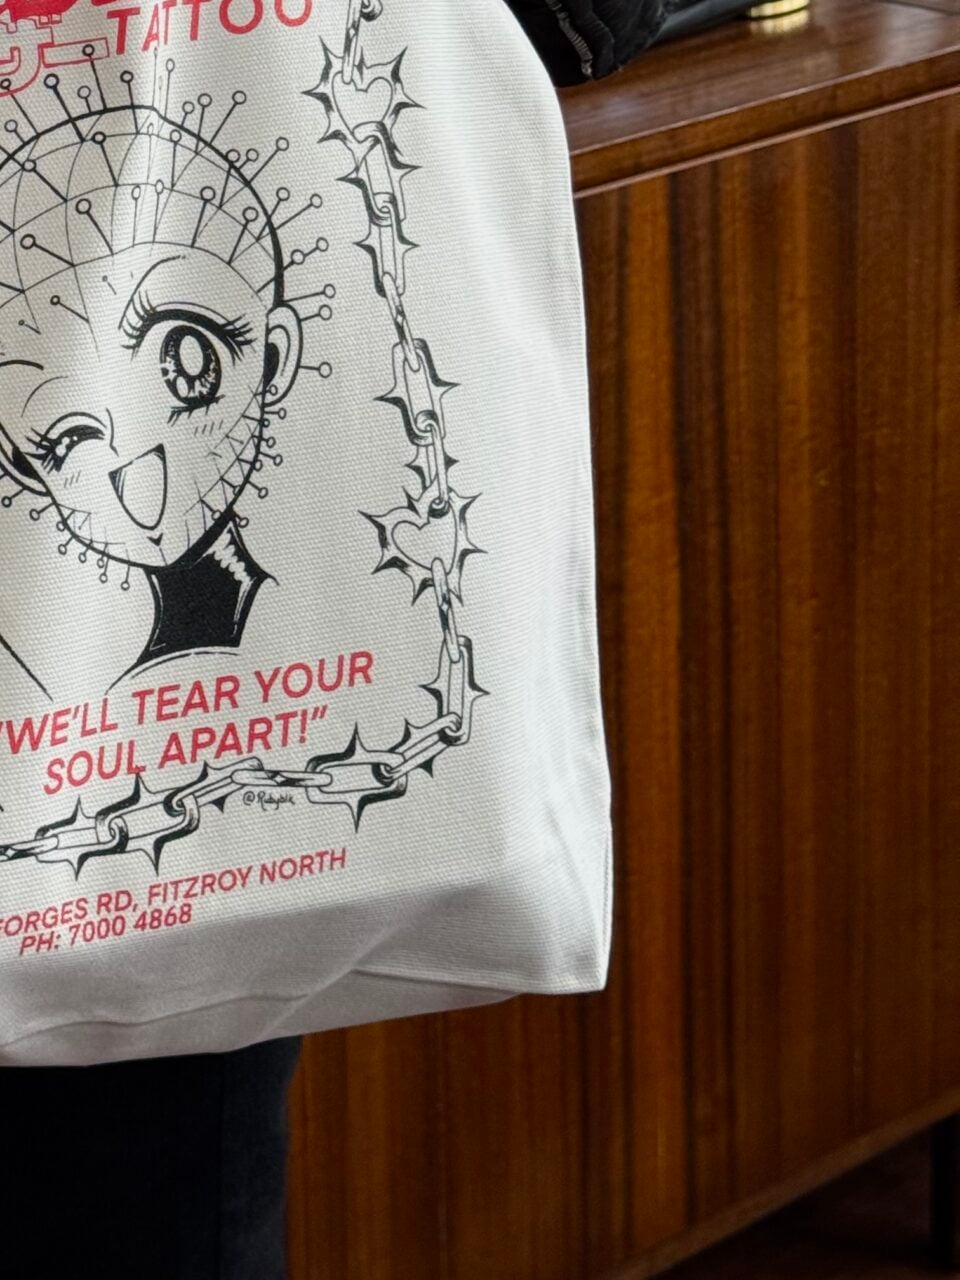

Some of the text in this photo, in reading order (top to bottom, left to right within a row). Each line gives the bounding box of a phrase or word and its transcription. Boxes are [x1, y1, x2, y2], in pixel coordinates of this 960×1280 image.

[132, 674, 240, 726] TEAR
[254, 650, 373, 704] YOUR
[43, 740, 147, 795] SOUL
[96, 890, 139, 915] RD,
[147, 867, 252, 906] FITZROY
[258, 848, 348, 886] NORTH
[19, 903, 194, 956] PH: 7000 4868
